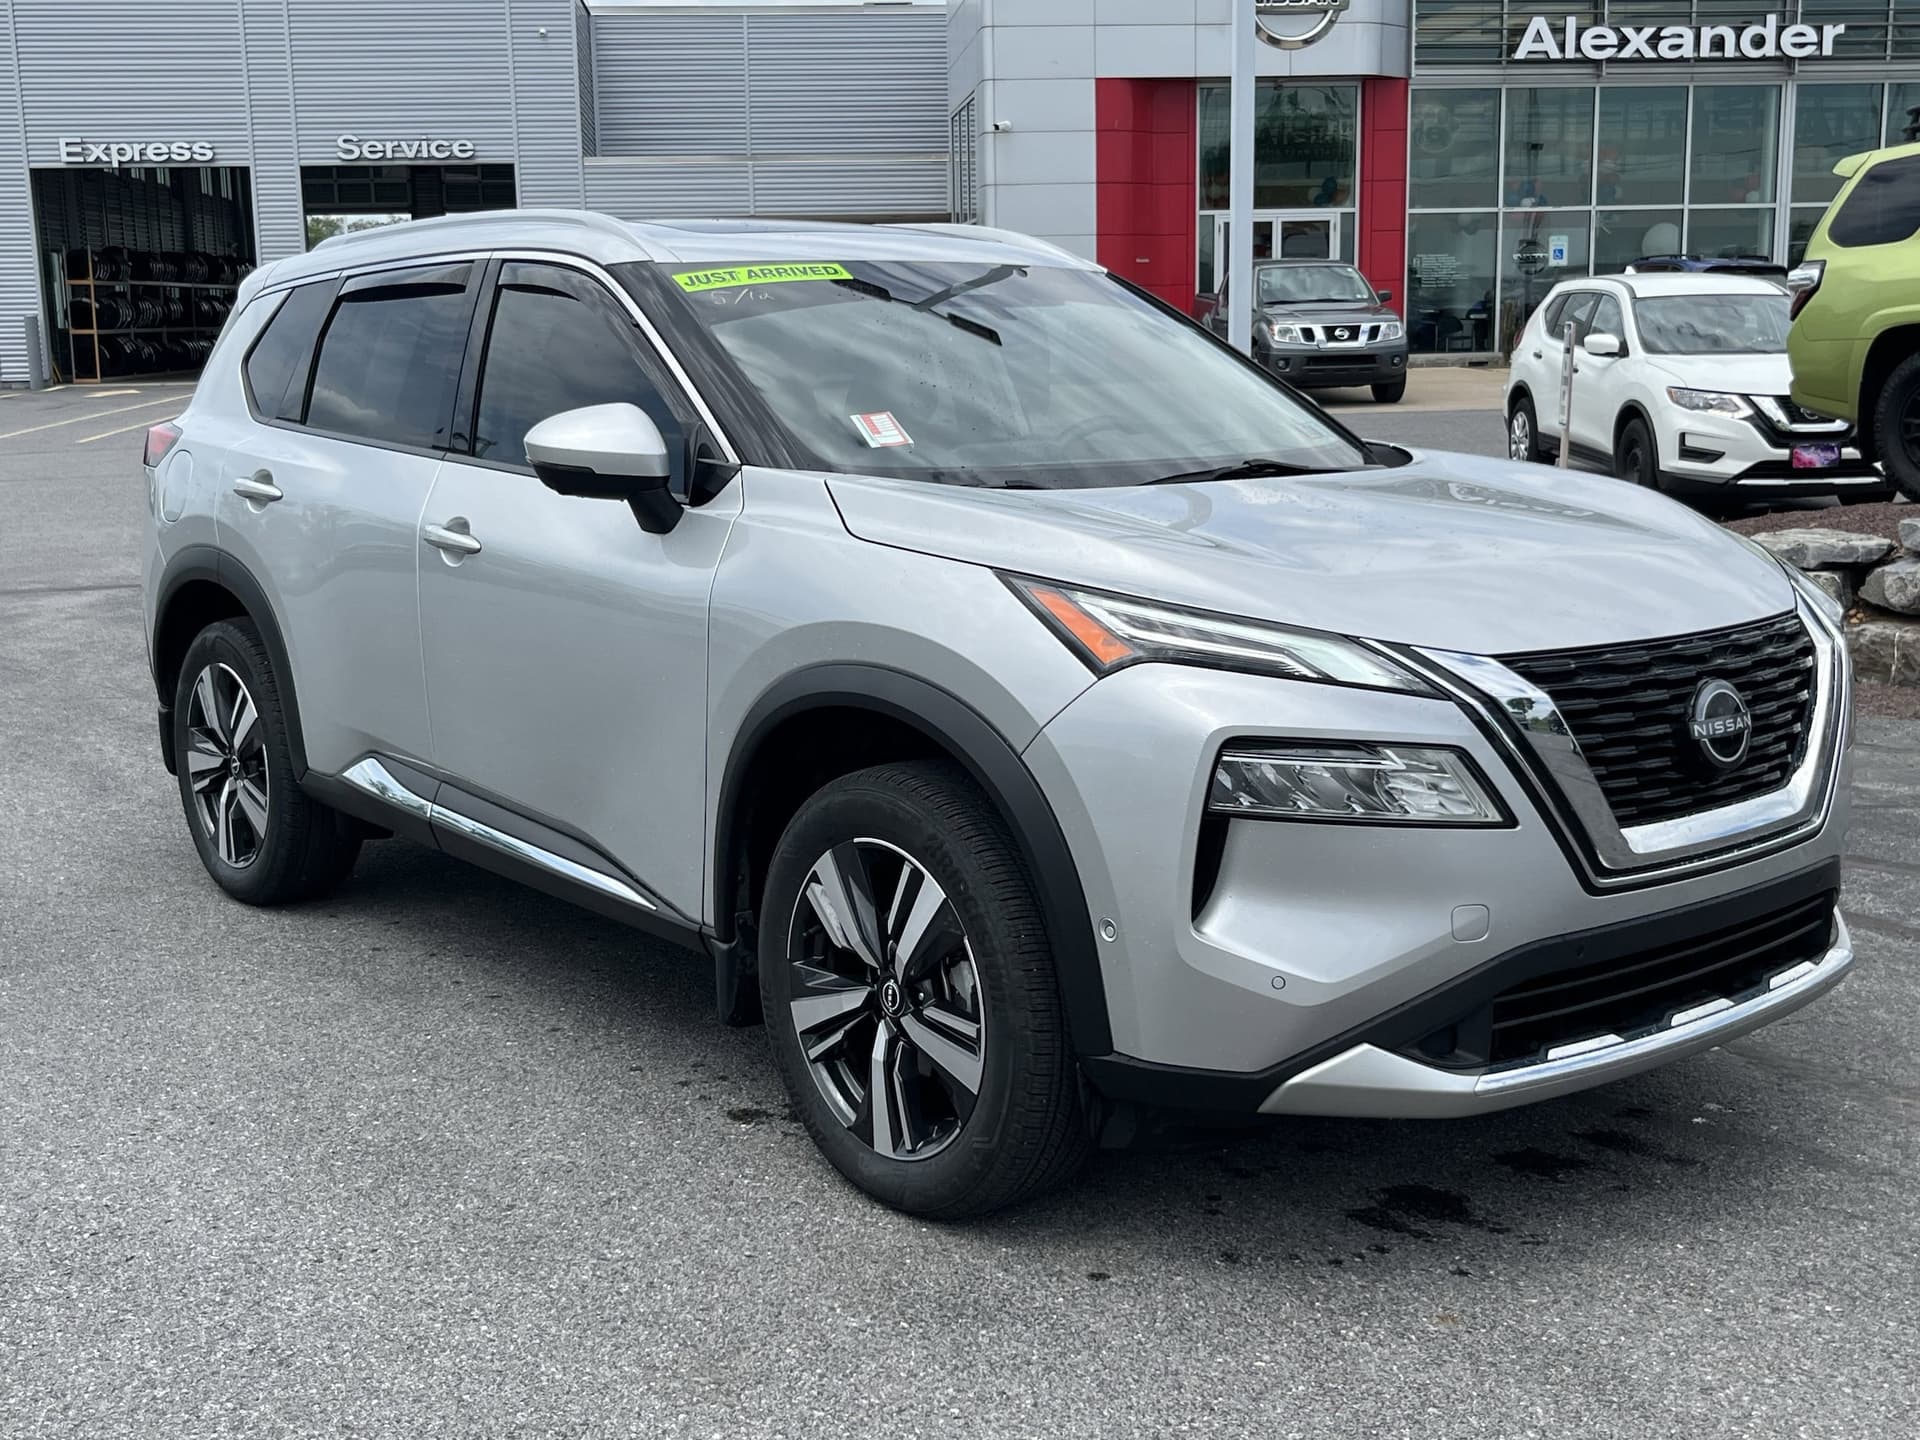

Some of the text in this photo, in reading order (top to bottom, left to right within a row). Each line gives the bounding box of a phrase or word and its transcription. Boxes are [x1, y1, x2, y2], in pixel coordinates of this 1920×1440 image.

[1513, 13, 1846, 60] Alexander
[58, 134, 475, 168] Express Service
[684, 265, 840, 287] JUST ARRIVED
[1693, 714, 1751, 737] NISSAN
